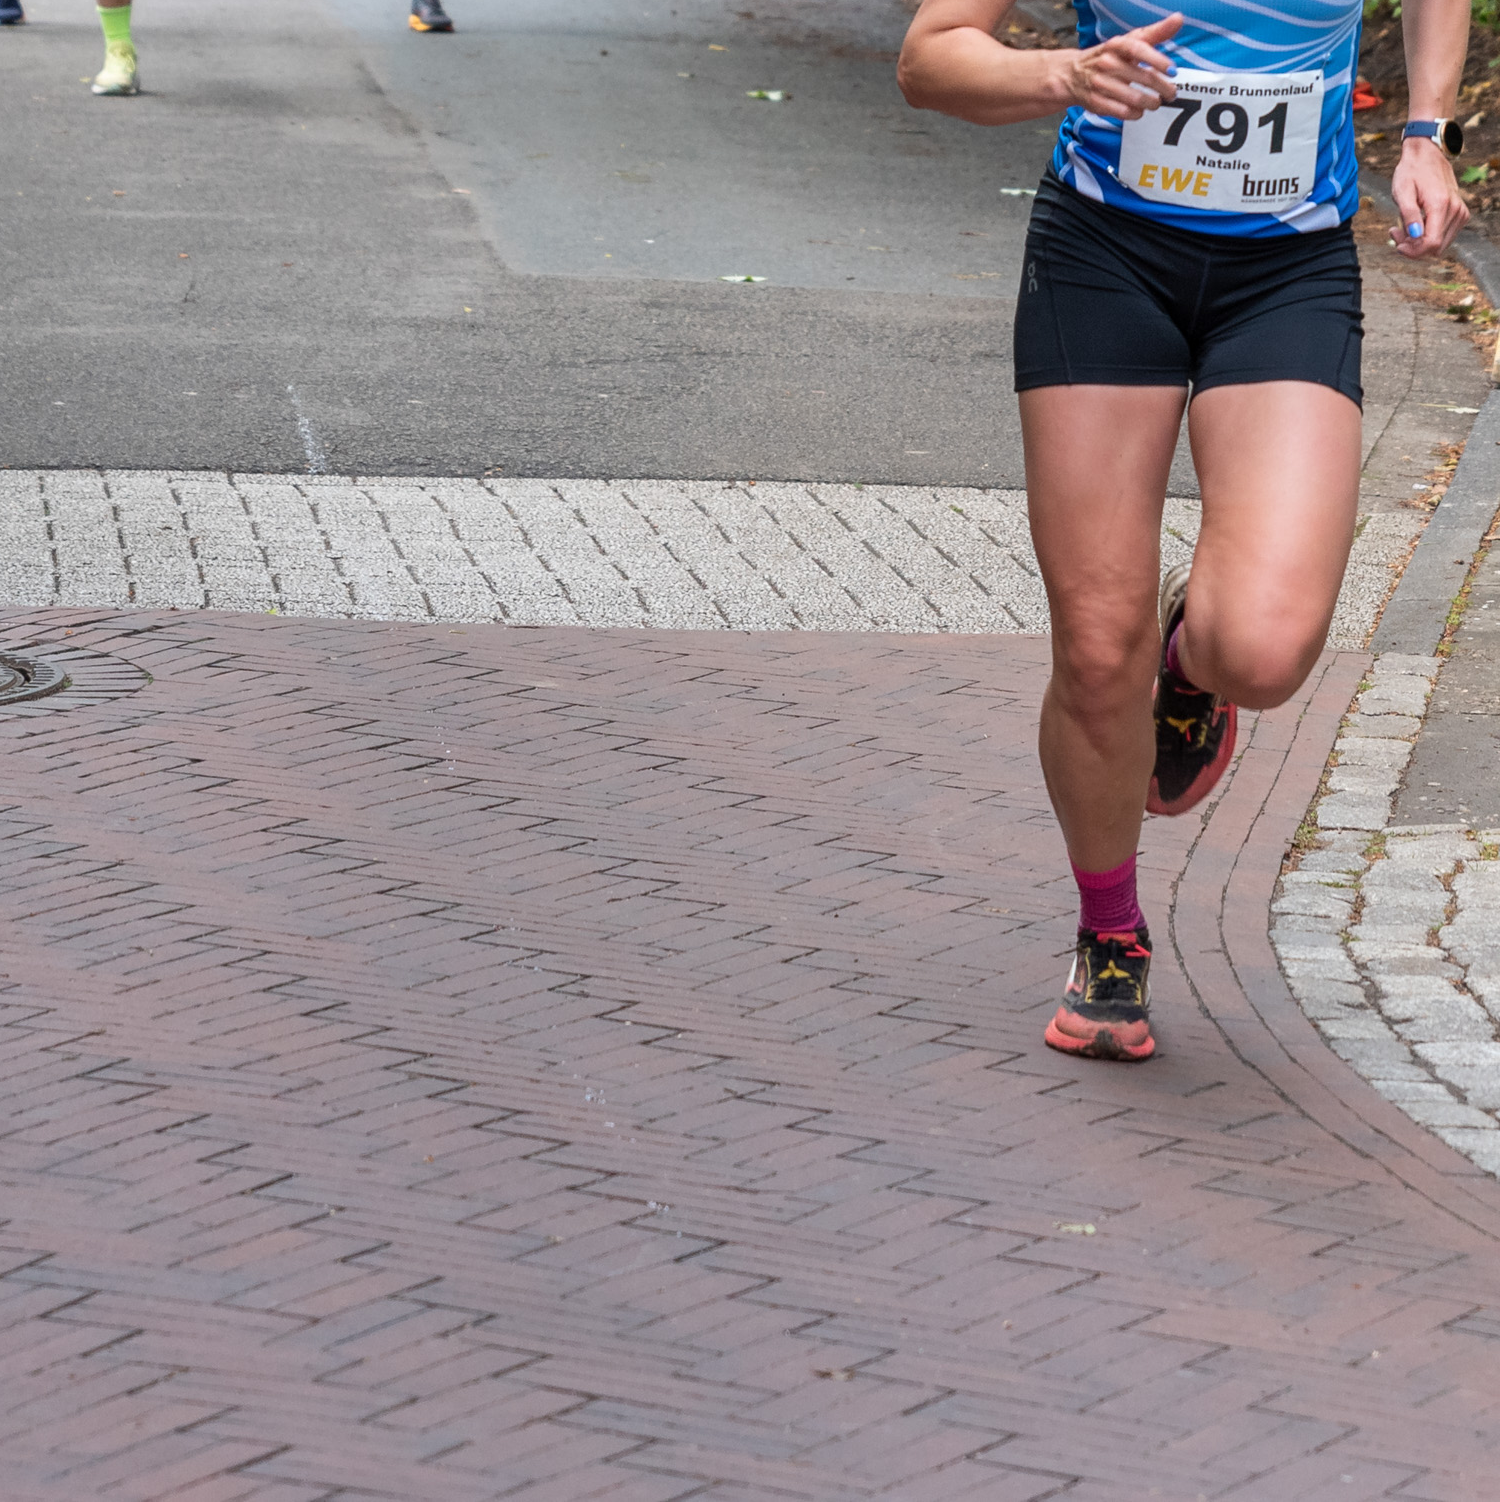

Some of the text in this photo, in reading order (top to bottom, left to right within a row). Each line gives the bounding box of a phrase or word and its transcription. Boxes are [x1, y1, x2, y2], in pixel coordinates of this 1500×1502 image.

[1175, 82, 1314, 97] stener Brunnenlauf
[1161, 97, 1289, 154] 791
[1196, 155, 1251, 170] Natalie
[1138, 163, 1299, 197] EWE bruns
